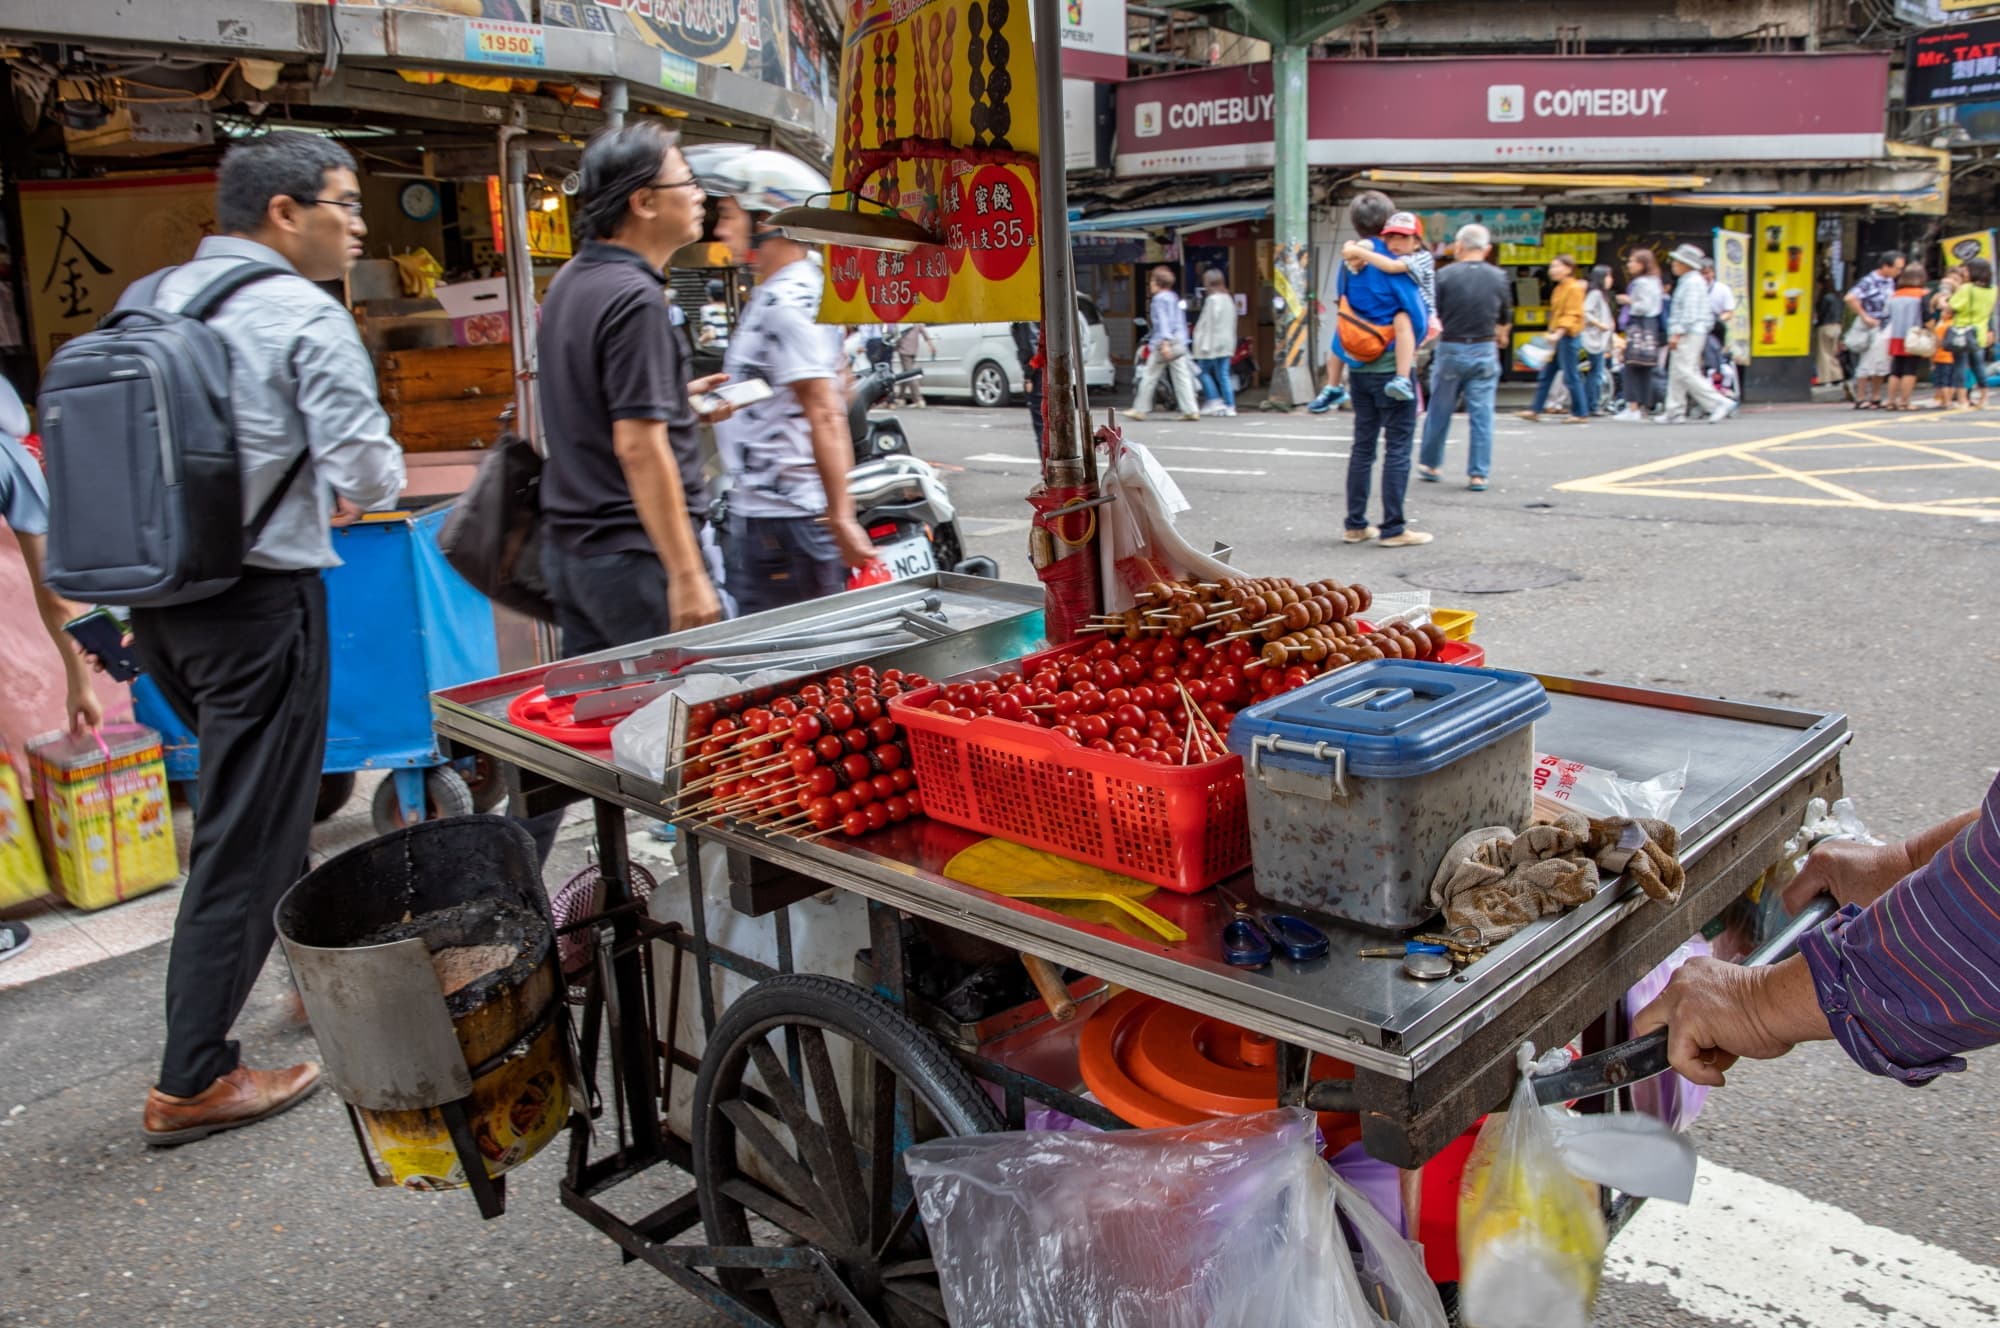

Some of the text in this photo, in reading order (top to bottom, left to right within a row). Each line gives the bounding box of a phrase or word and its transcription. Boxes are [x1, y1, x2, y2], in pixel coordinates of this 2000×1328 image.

[486, 34, 529, 53] 1950
[1062, 28, 1094, 43] OMEBUY
[1917, 51, 1950, 67] Mr.
[1168, 93, 1274, 129] COMEBUY
[1533, 88, 1667, 117] COMEBUY
[41, 206, 114, 318] 金
